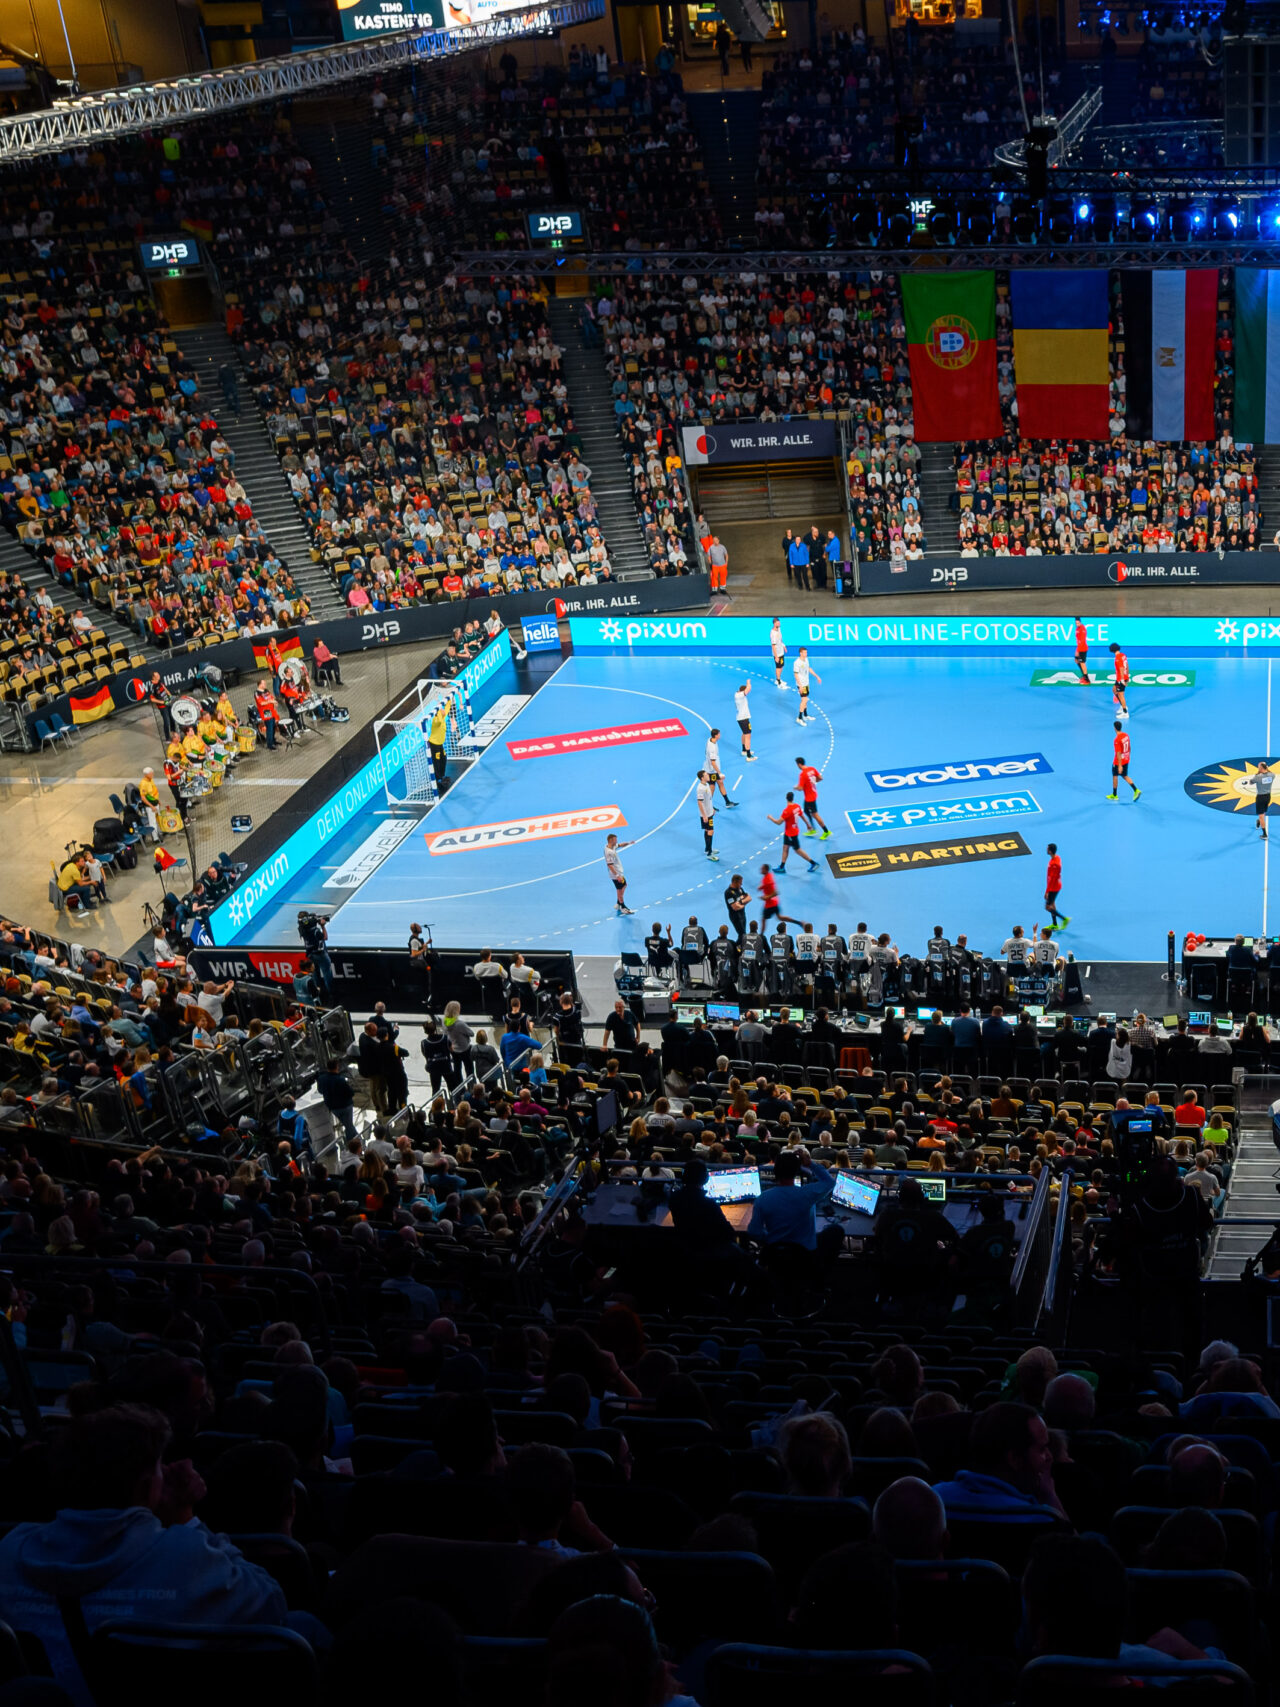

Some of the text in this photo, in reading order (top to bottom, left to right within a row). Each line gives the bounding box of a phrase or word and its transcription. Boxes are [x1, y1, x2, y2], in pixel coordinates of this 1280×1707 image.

[380, 3, 403, 13] TIMO
[354, 13, 433, 30] KASTENING
[538, 216, 572, 231] DHB
[152, 243, 188, 261] DHB
[730, 434, 813, 449] WIR. IHR. ALLE.
[930, 567, 968, 582] DHB
[1122, 566, 1200, 577] WIR. IHR. ALLE.
[560, 595, 641, 612] WIR. IHR. ALLE.
[361, 620, 401, 640] DHB
[523, 624, 559, 641] hella
[626, 622, 707, 646] pixum
[809, 623, 1109, 642] DEIN ONLINE-FOTOSERVCE
[474, 643, 503, 689] pixum
[512, 724, 682, 755] DAS HANDWERK
[872, 758, 1041, 788] brother
[902, 797, 1029, 825] pixum
[317, 803, 345, 841] DEIN
[435, 813, 614, 848] AUTOHERO
[352, 820, 417, 872] travelite
[887, 839, 1019, 864] HARTING
[839, 858, 880, 867] HARTING
[243, 853, 289, 922] pixum
[800, 941, 812, 952] 36
[852, 940, 865, 951] 80
[1010, 950, 1024, 961] 25
[1042, 950, 1048, 961] 3
[209, 961, 254, 978] WIR.
[258, 961, 295, 978] IHR
